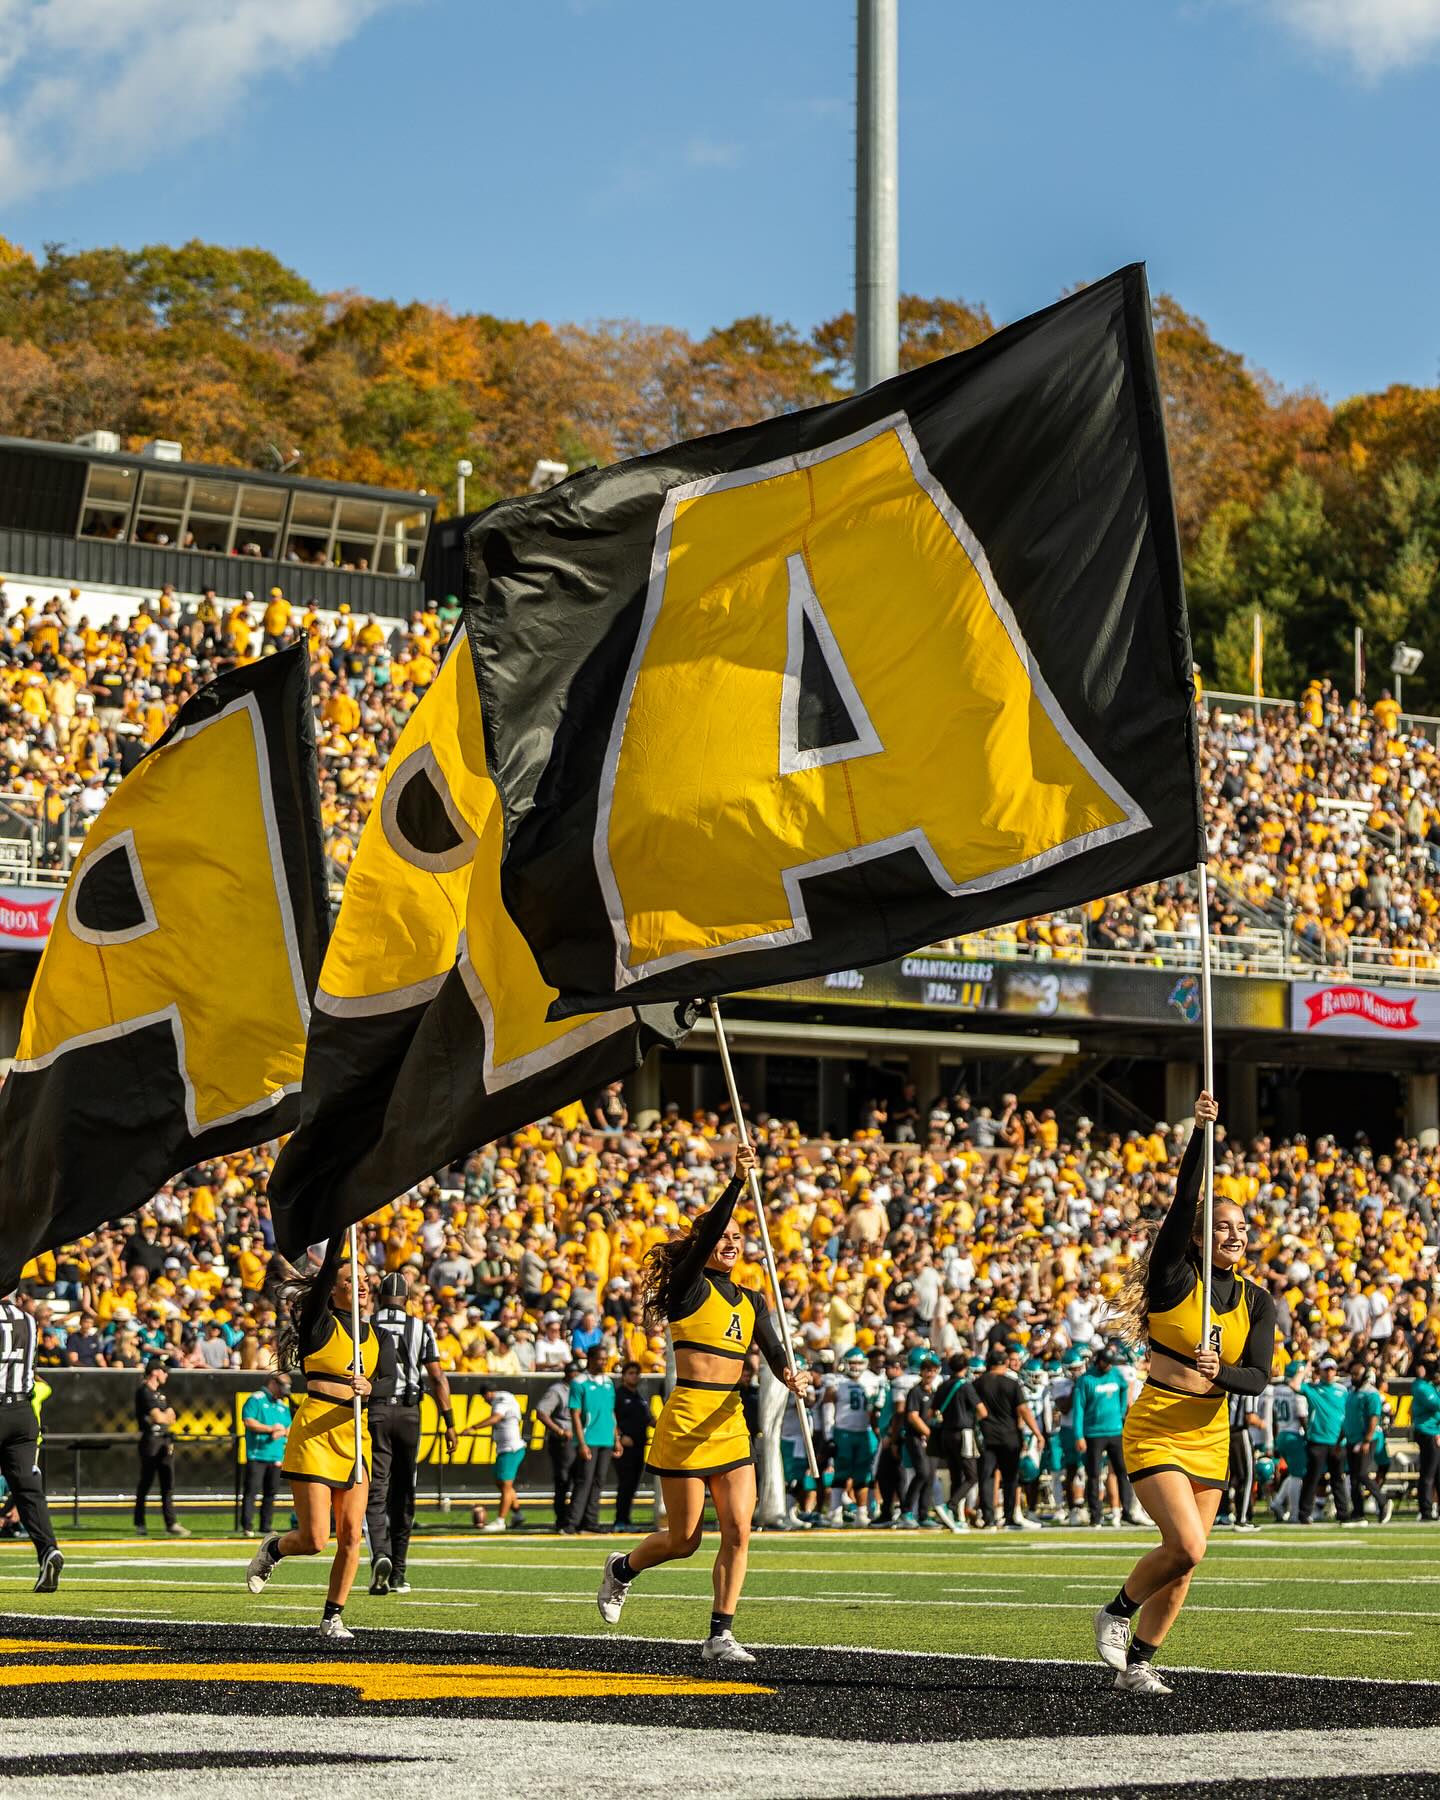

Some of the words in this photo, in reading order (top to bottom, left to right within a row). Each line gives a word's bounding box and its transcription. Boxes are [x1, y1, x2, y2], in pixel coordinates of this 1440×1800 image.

[593, 410, 1153, 992] A
[901, 957, 993, 981] CHANTICLEERS
[1039, 974, 1060, 1017] 3
[724, 1312, 743, 1342] A
